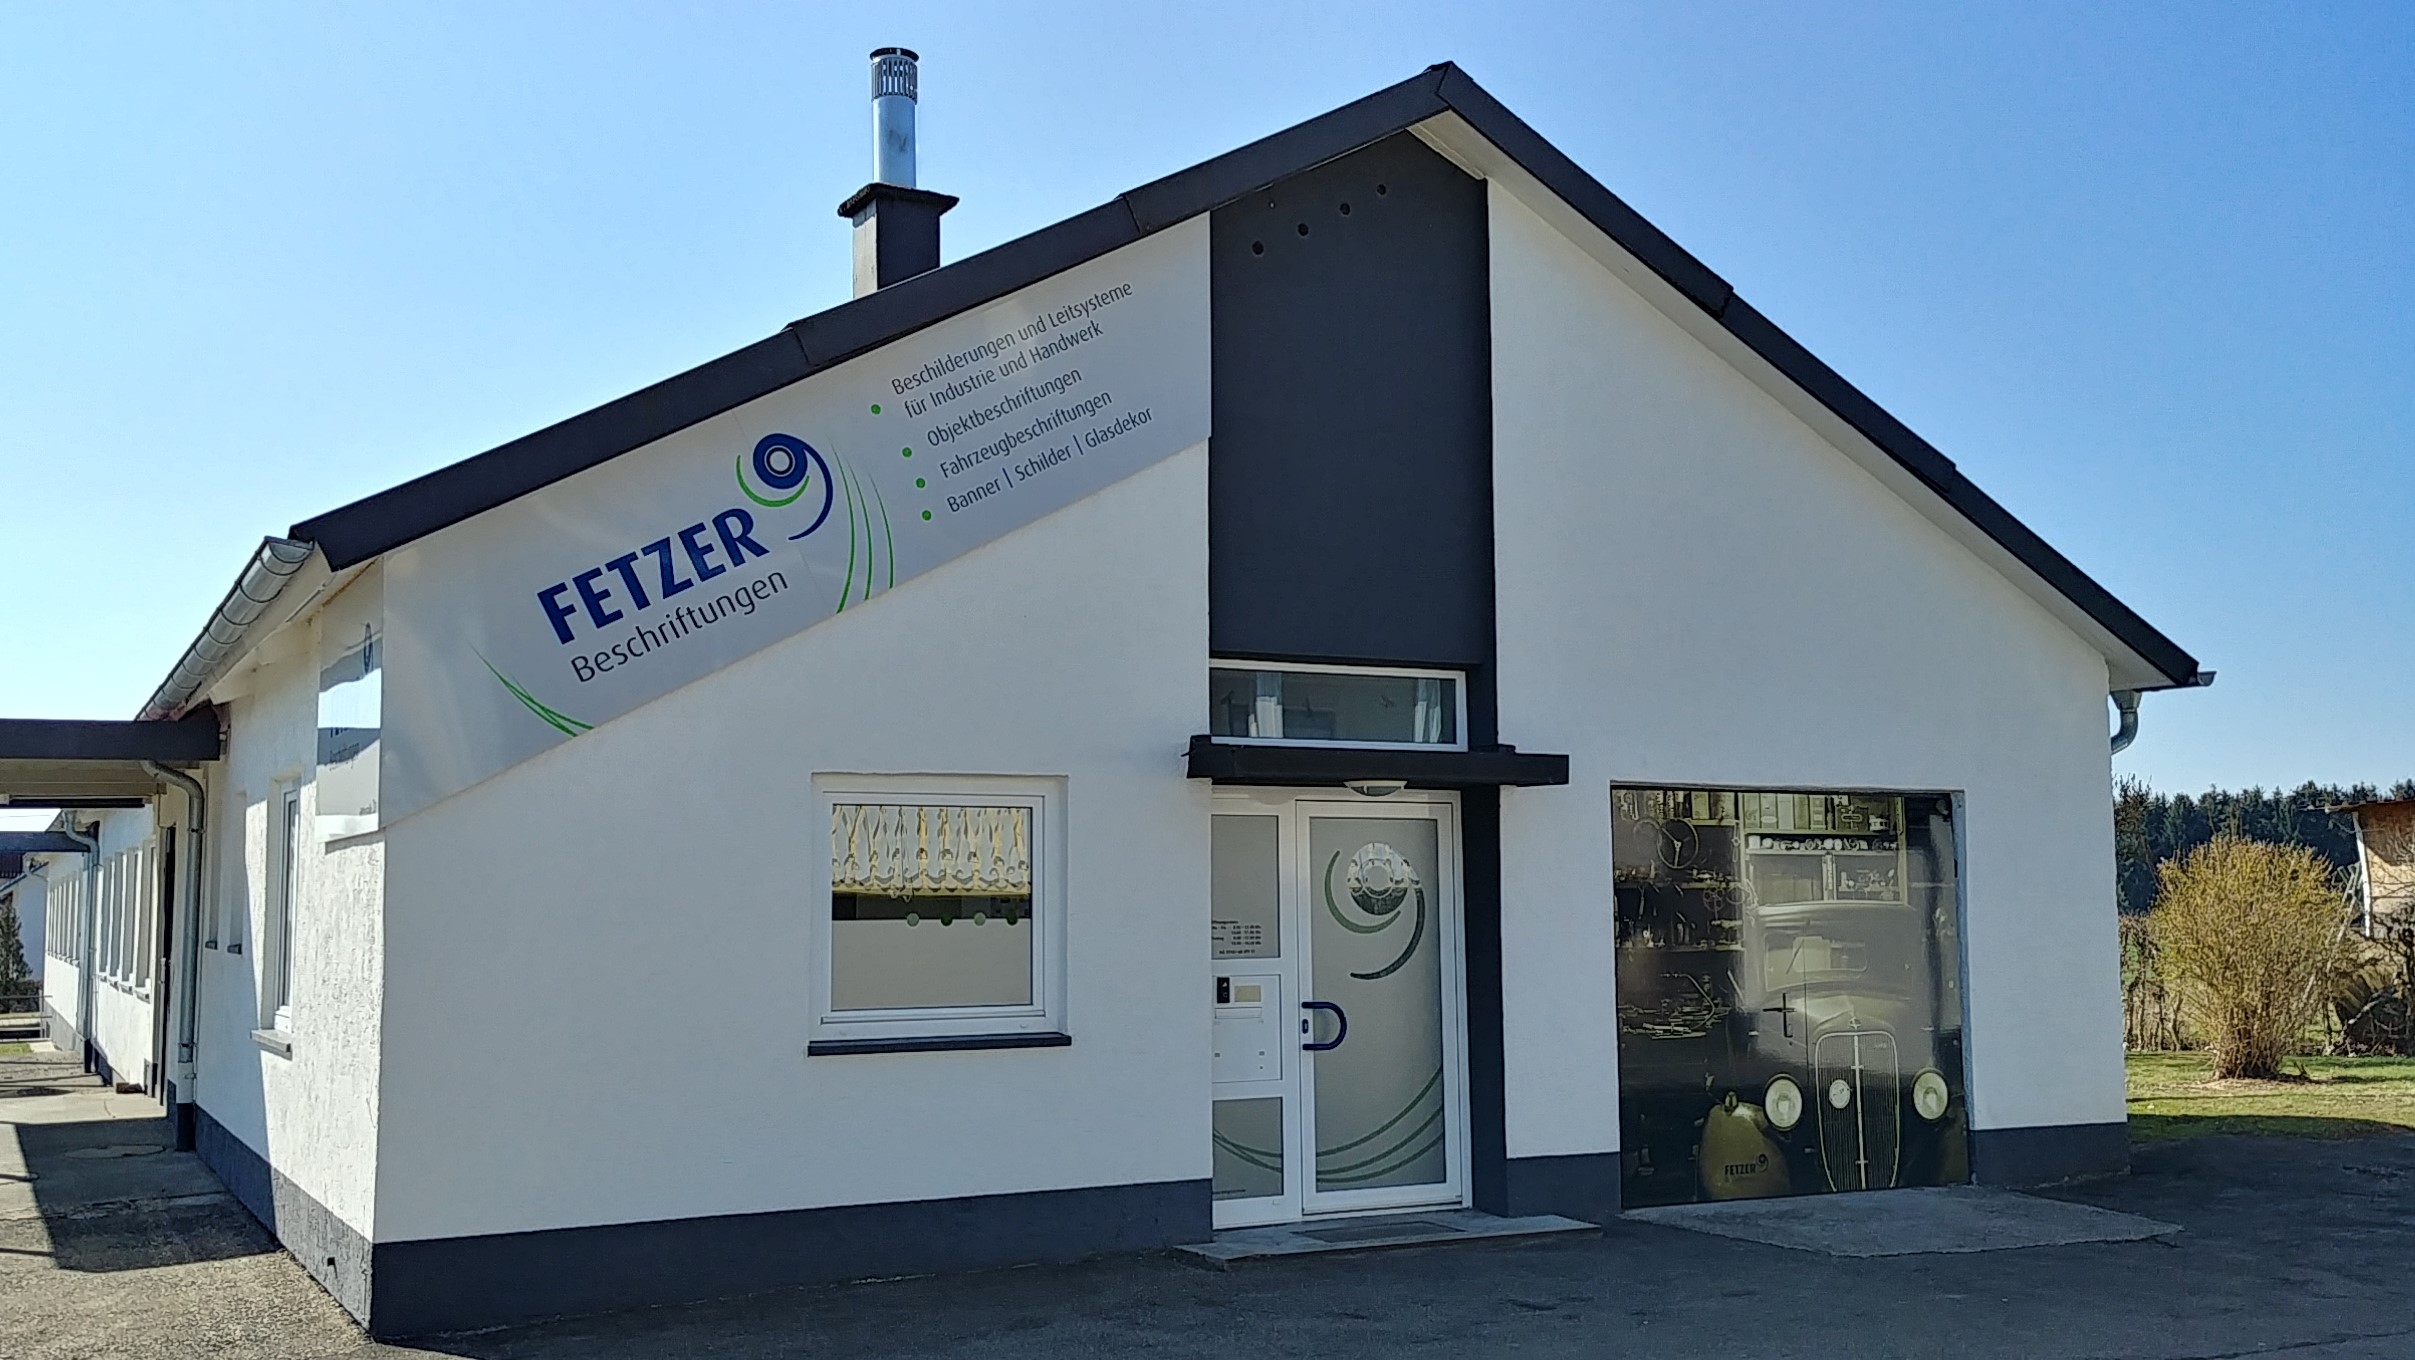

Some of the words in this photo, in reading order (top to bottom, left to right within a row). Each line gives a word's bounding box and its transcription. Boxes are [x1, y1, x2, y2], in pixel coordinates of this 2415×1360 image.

[891, 332, 1016, 395] Beschilderungen
[1018, 316, 1047, 341] und
[1047, 282, 1133, 328] Leitsysteme
[904, 399, 928, 418] für
[930, 369, 997, 408] Industrie
[999, 351, 1029, 377] und
[1029, 320, 1104, 364] Handwerk
[927, 368, 1082, 447] Objektbeschriftungen
[939, 391, 1112, 479] Fahrzeugbeschriftungen
[946, 478, 1002, 513] Banner
[1015, 444, 1072, 482] Schilder
[1084, 407, 1153, 449] Glasdekor
[537, 508, 770, 645] FETZER
[571, 572, 789, 682] Beschriftungen
[1724, 1163, 1757, 1176] FETZER
